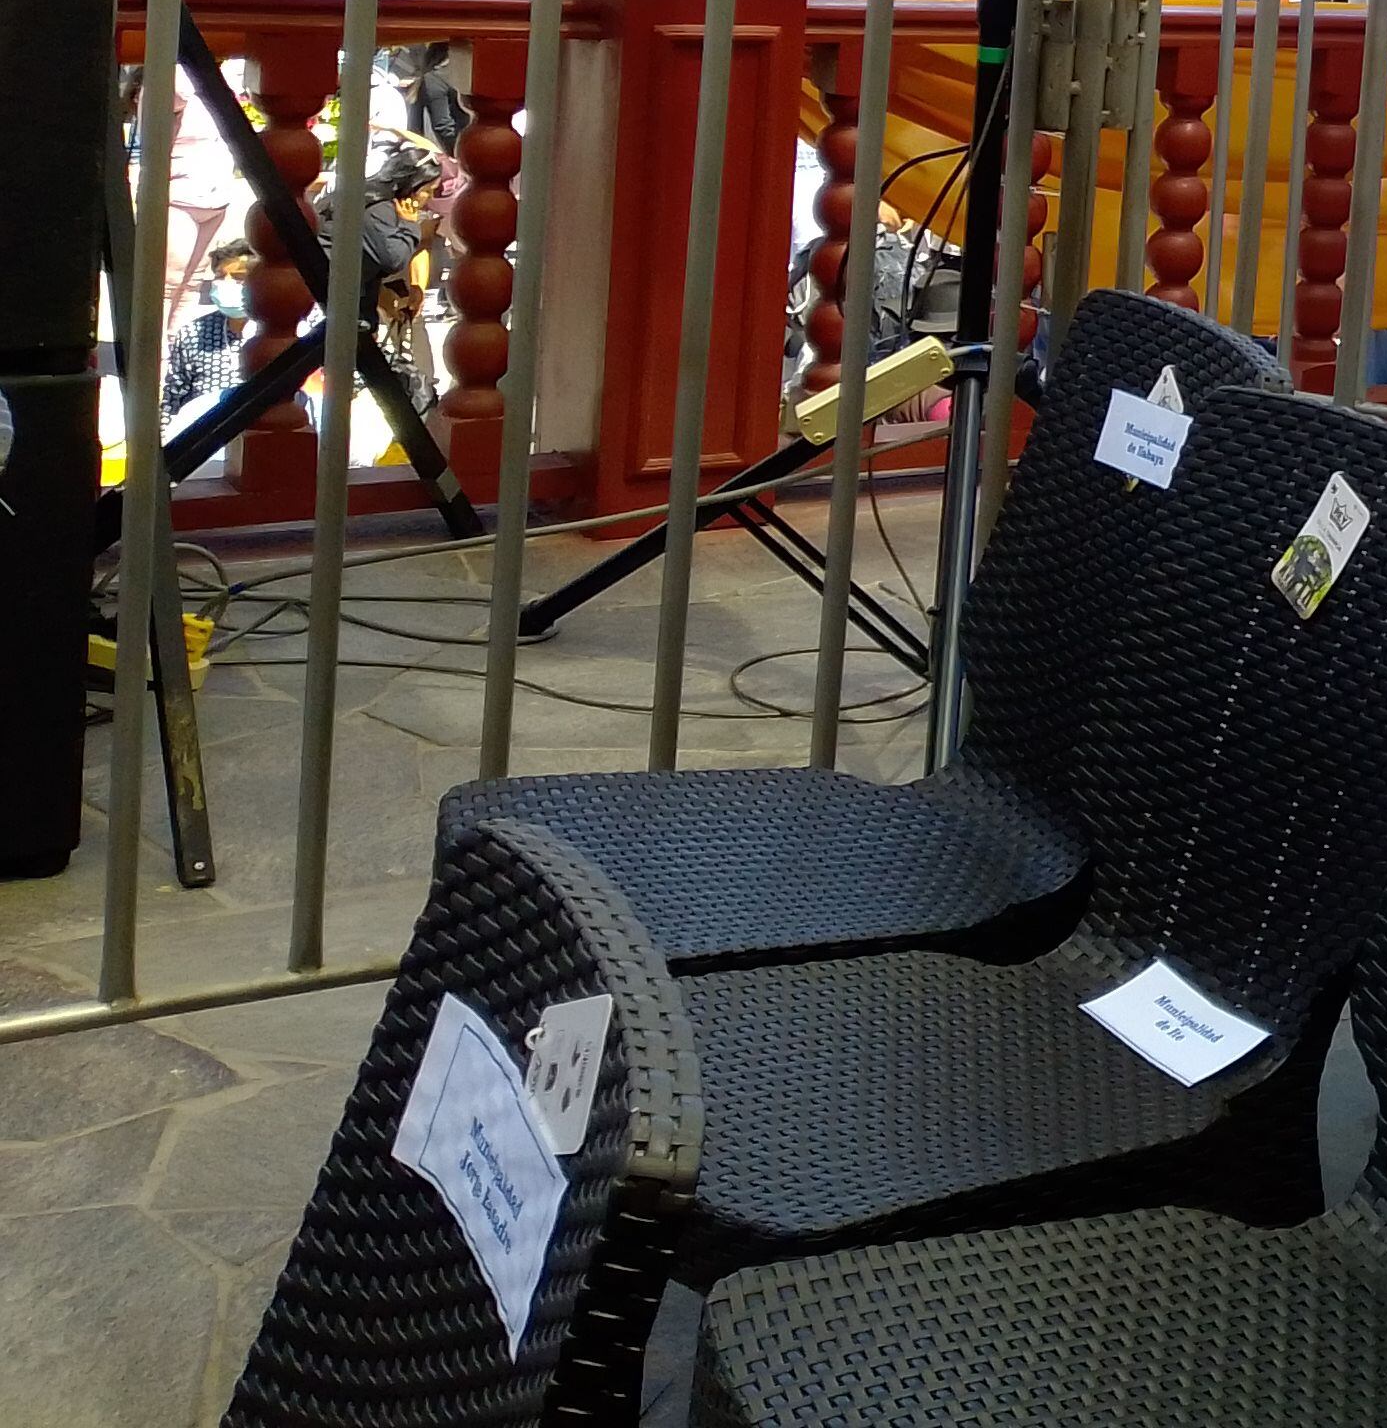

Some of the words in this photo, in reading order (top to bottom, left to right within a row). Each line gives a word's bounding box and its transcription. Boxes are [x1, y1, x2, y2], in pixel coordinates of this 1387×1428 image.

[1124, 422, 1176, 452] Municipalidad
[1154, 995, 1224, 1044] Municipalidad
[1155, 1019, 1170, 1031] de
